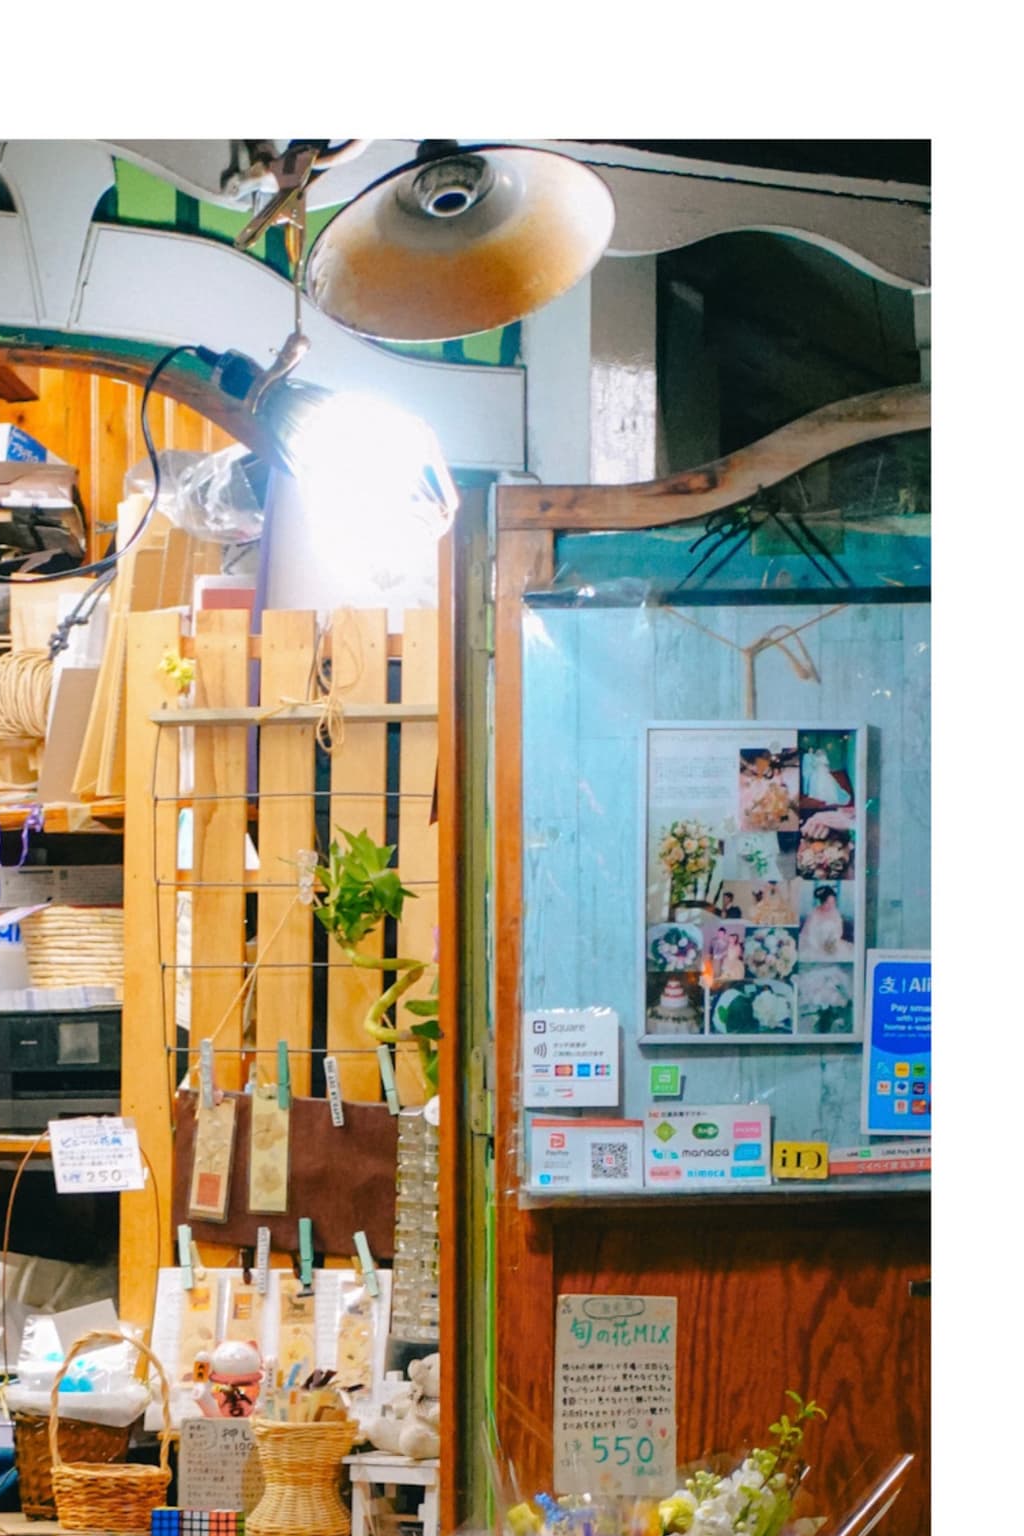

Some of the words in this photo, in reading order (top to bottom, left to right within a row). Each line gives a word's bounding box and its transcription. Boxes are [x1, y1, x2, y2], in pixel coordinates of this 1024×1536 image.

[890, 1003, 908, 1014] Pay
[549, 1022, 586, 1033] Square
[884, 1023, 906, 1031] home
[681, 1148, 730, 1158] manaca
[779, 1148, 823, 1171] iD
[86, 1169, 123, 1184] 250
[687, 1168, 726, 1178] nimoca
[570, 1316, 671, 1349] 旬の花MIX
[592, 1435, 655, 1466] 550
